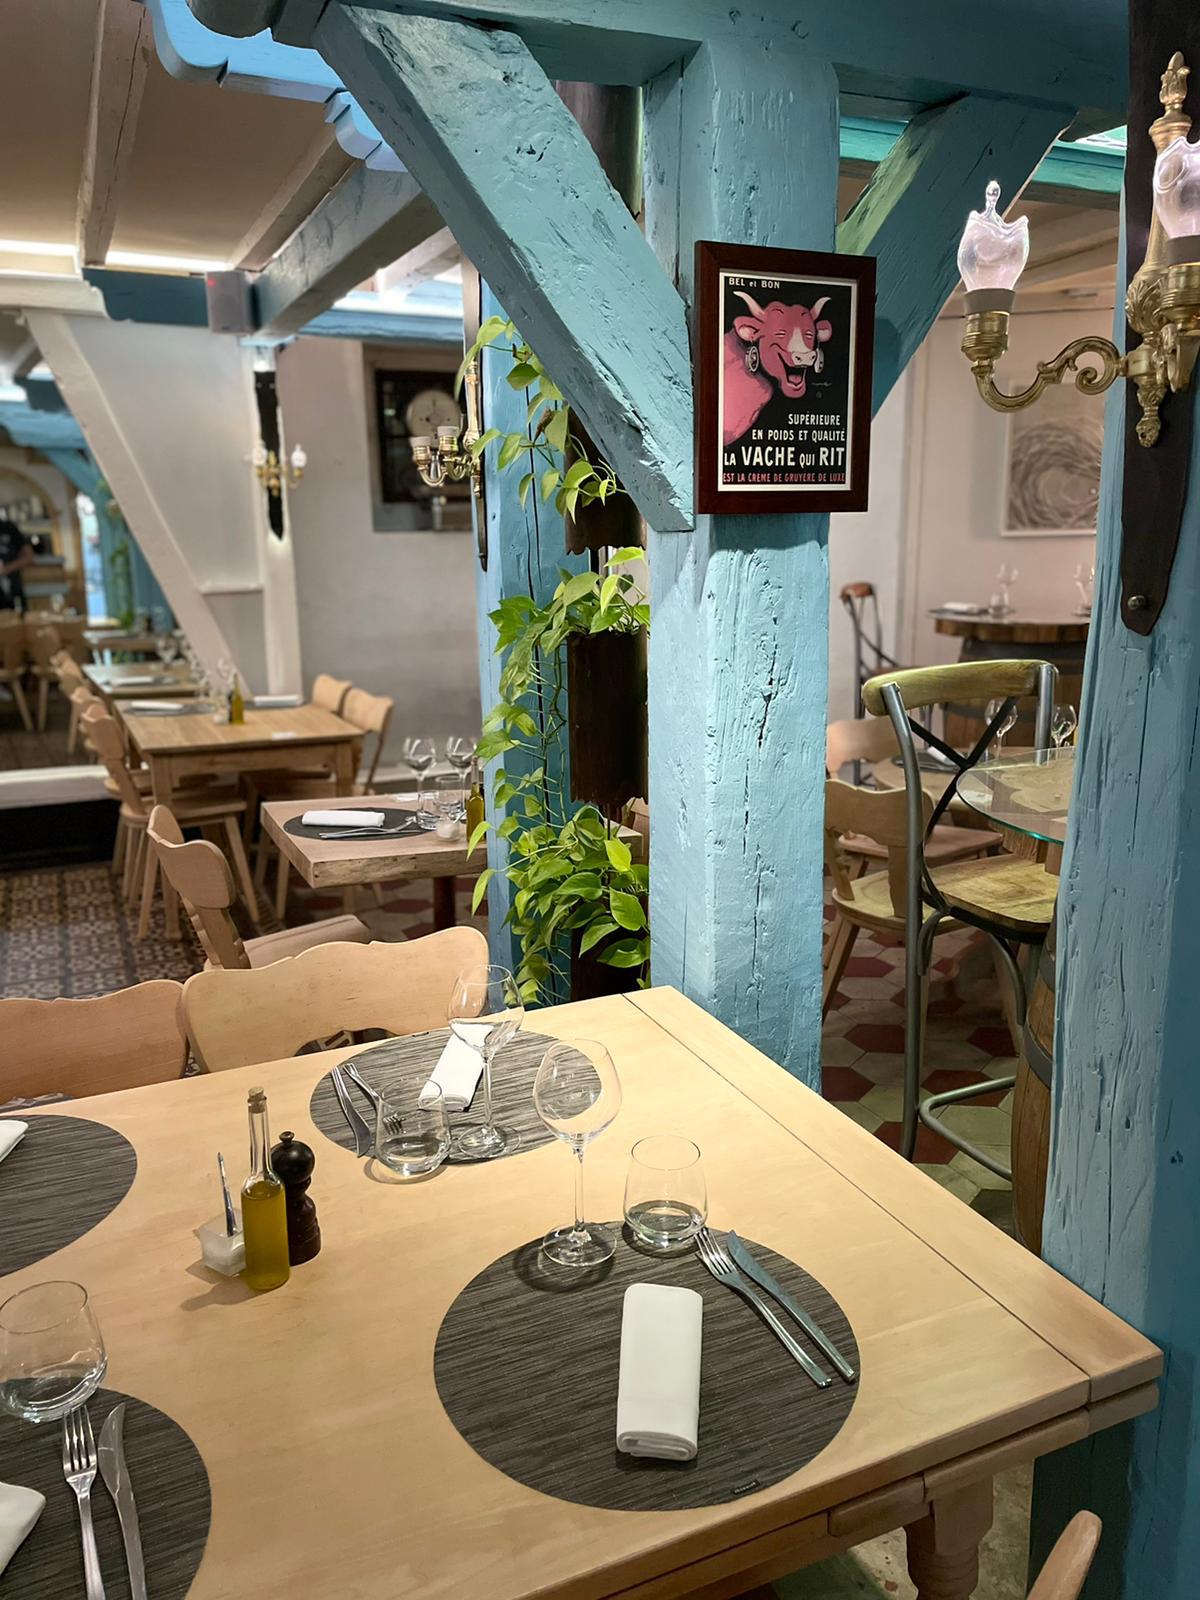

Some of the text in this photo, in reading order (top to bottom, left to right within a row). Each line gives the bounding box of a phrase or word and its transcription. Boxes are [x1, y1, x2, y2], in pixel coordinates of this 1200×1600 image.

[728, 277, 746, 287] BEL
[761, 280, 780, 289] BON
[788, 411, 840, 426] SUPÉRIEURE
[752, 428, 846, 443] EN POIDS ET QUALITÉ
[724, 446, 845, 468] LA VACHE QUI RIT
[723, 472, 735, 482] EST
[737, 472, 746, 482] LA
[774, 472, 782, 482] DE
[818, 472, 827, 482] DE
[830, 472, 846, 482] LUXE
